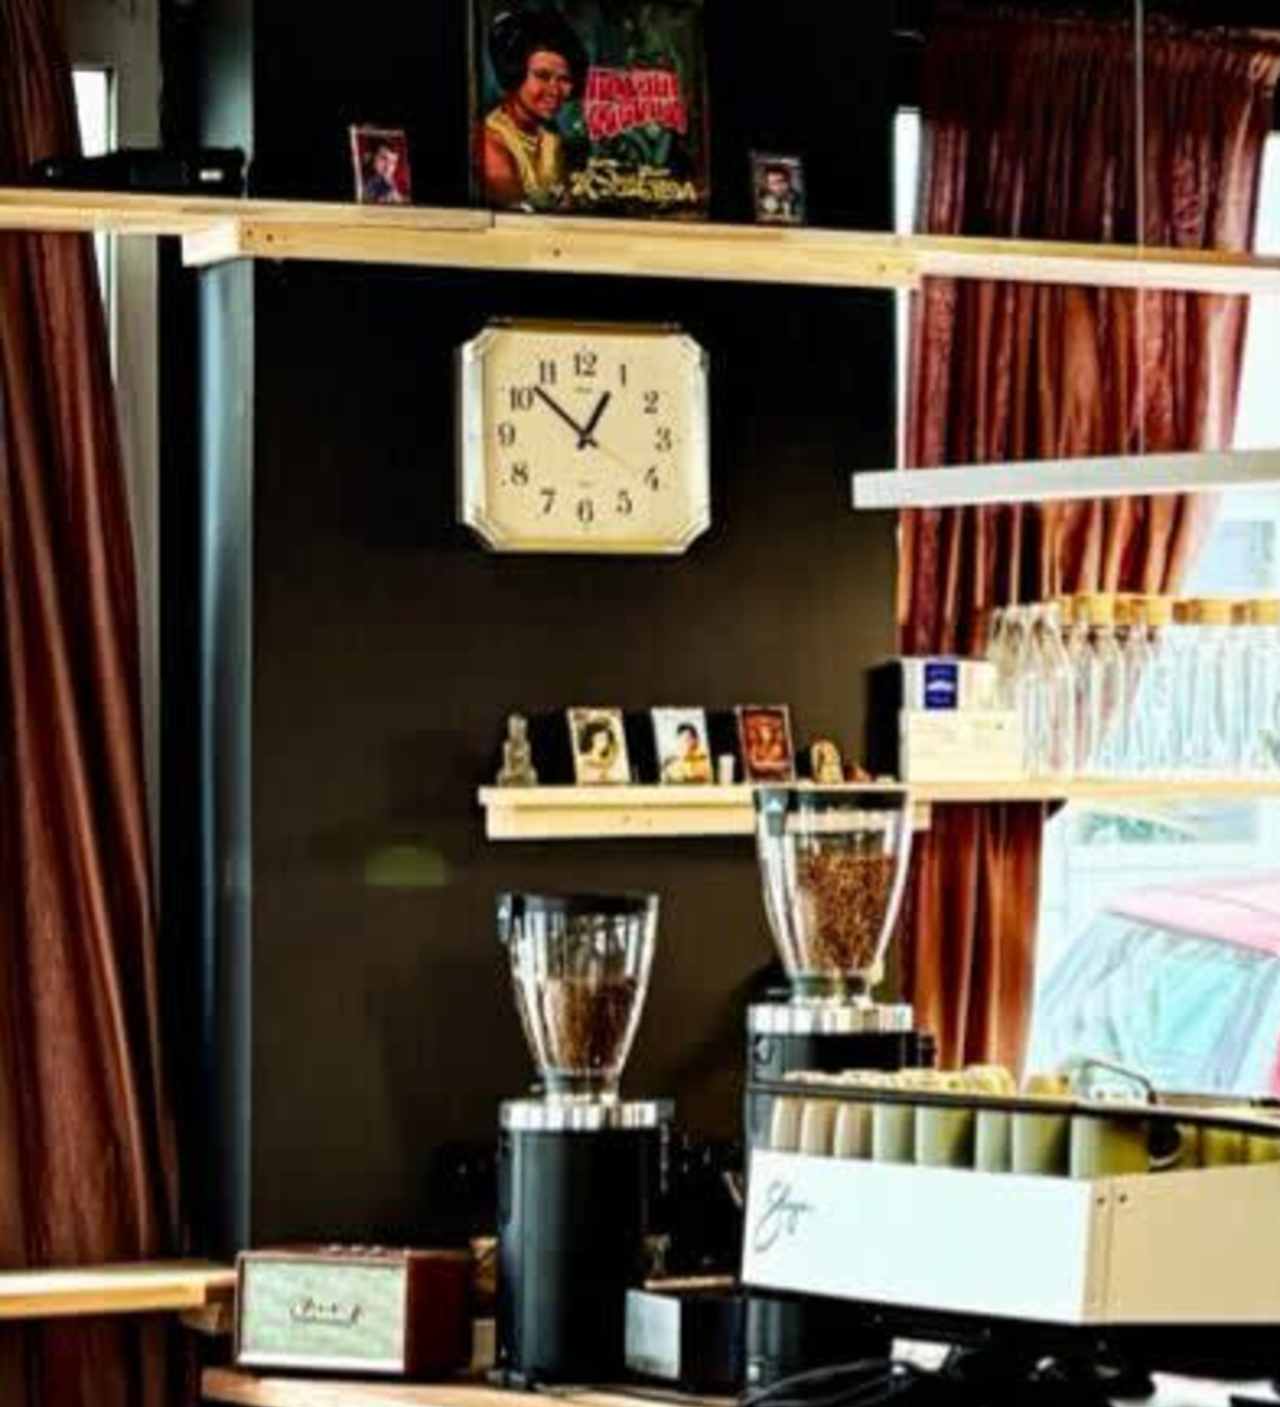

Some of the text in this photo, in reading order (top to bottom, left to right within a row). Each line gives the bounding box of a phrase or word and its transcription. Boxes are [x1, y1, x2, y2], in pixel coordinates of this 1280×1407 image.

[539, 360, 558, 384] 11
[573, 352, 597, 377] 12
[618, 363, 628, 387] 1
[509, 387, 534, 411] 10
[643, 391, 660, 414] 2
[498, 423, 516, 446] 9
[654, 427, 673, 451] 3
[511, 462, 529, 486] 8
[643, 466, 660, 491] 4
[540, 490, 557, 514] 7
[577, 499, 594, 524] 6
[616, 492, 633, 514] 5
